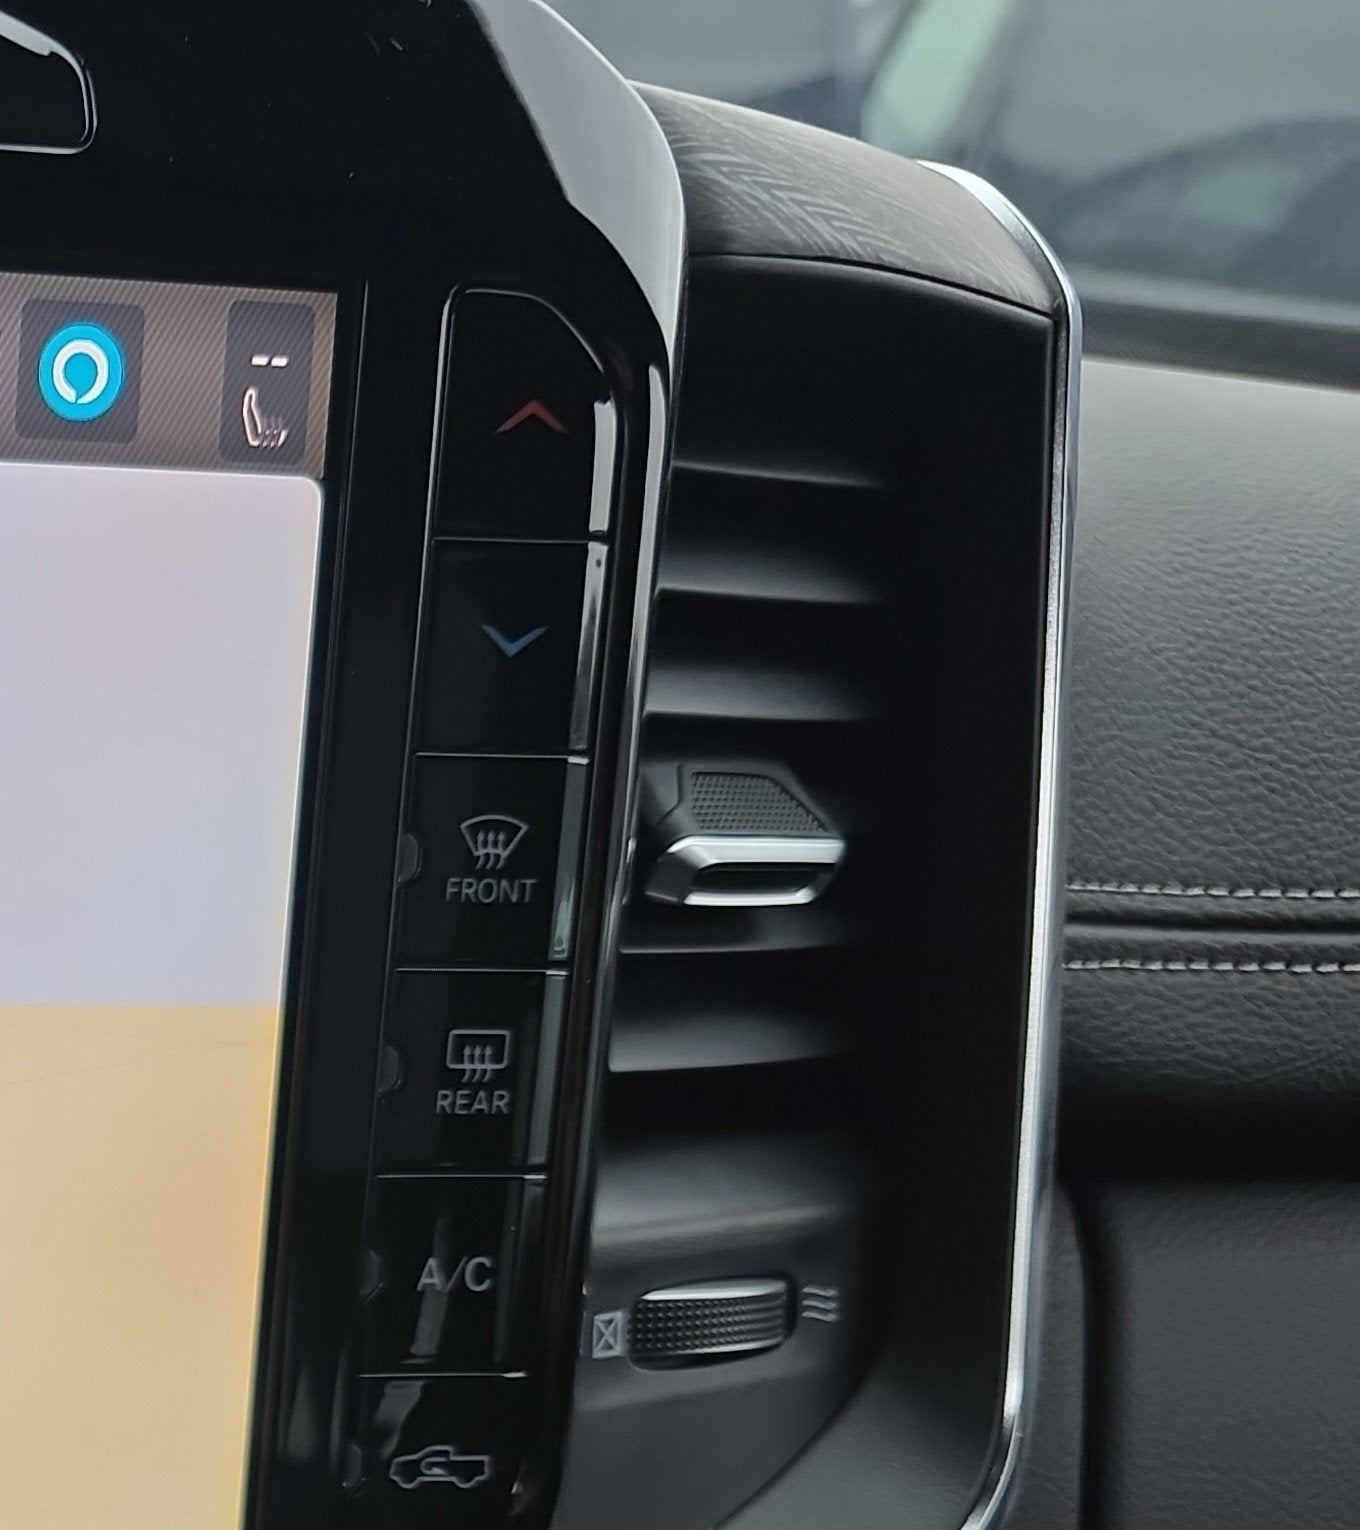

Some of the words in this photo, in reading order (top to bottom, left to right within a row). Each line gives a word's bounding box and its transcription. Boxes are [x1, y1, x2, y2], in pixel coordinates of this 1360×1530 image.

[445, 877, 539, 905] FRONT
[435, 1089, 512, 1116] REAR
[415, 1255, 495, 1294] A/C
